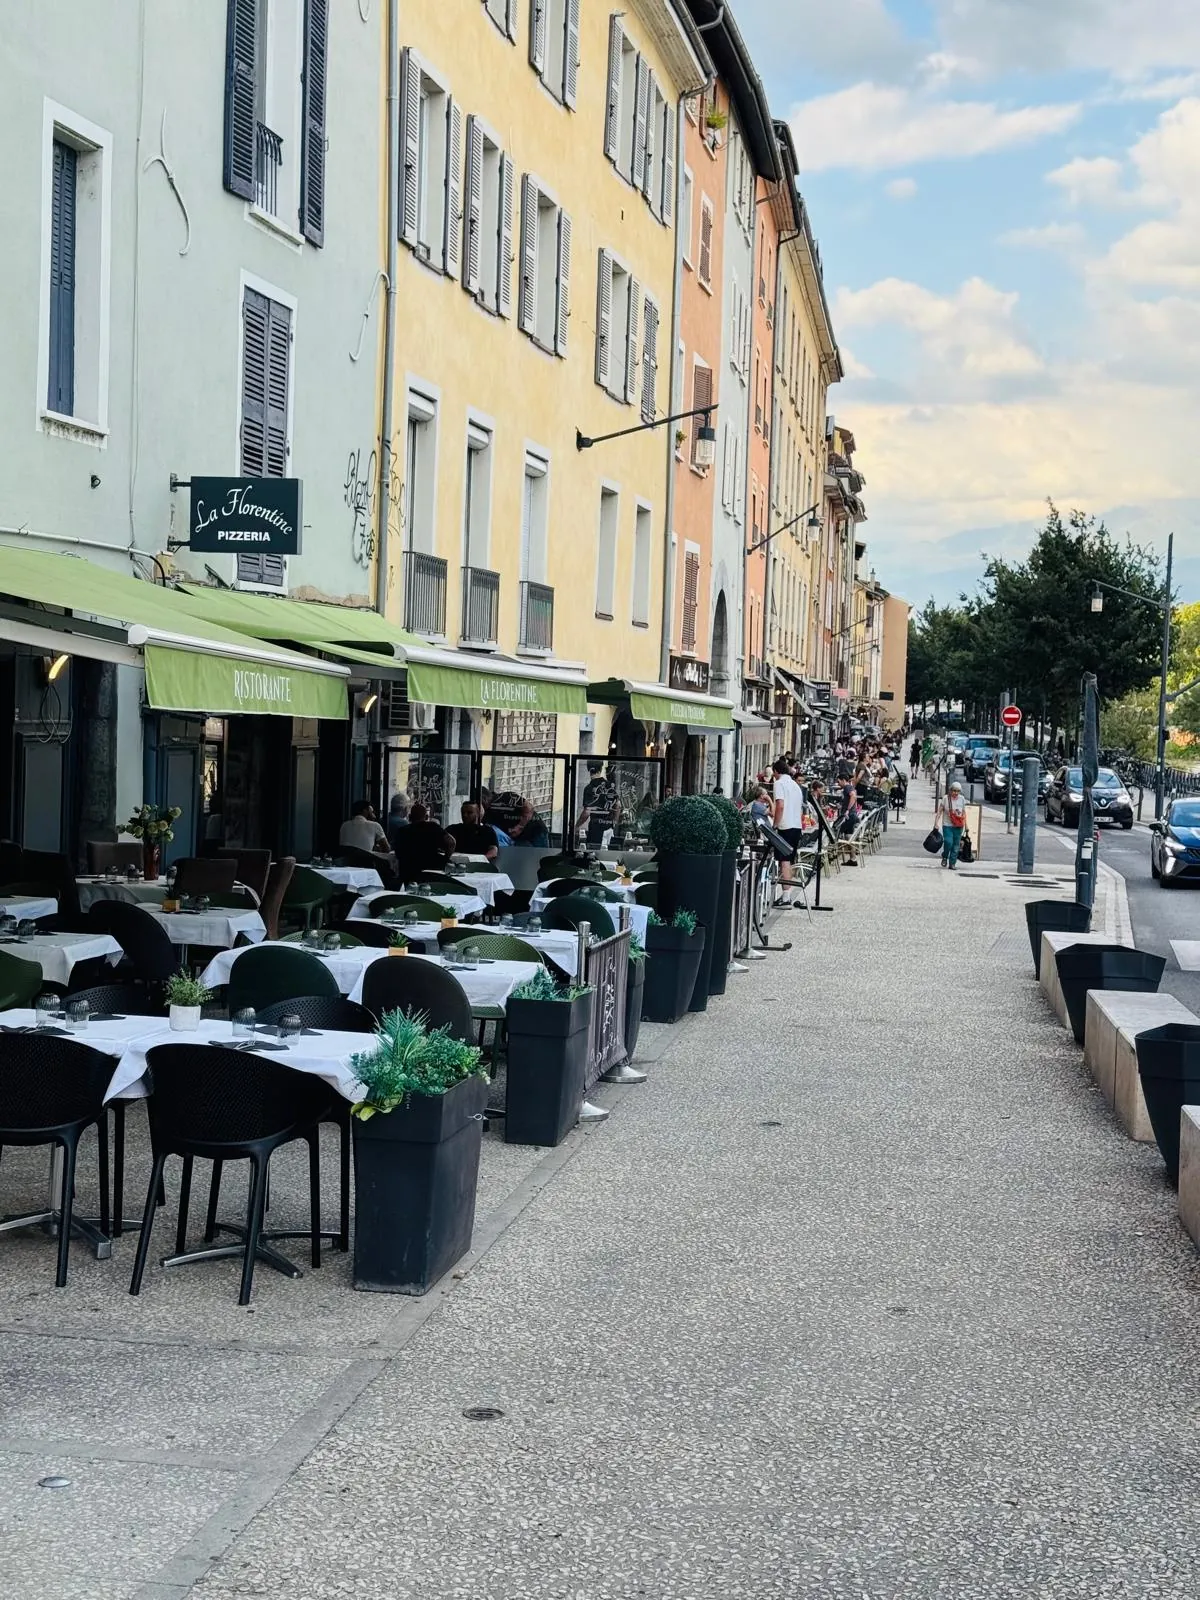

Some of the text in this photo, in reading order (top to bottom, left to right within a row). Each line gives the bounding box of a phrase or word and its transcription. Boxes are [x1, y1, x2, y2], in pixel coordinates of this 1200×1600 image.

[195, 485, 293, 535] La Florentine
[217, 530, 271, 542] PIZZERIA
[234, 670, 292, 705] RISTORANTE
[480, 679, 537, 704] LA FLORENTINE
